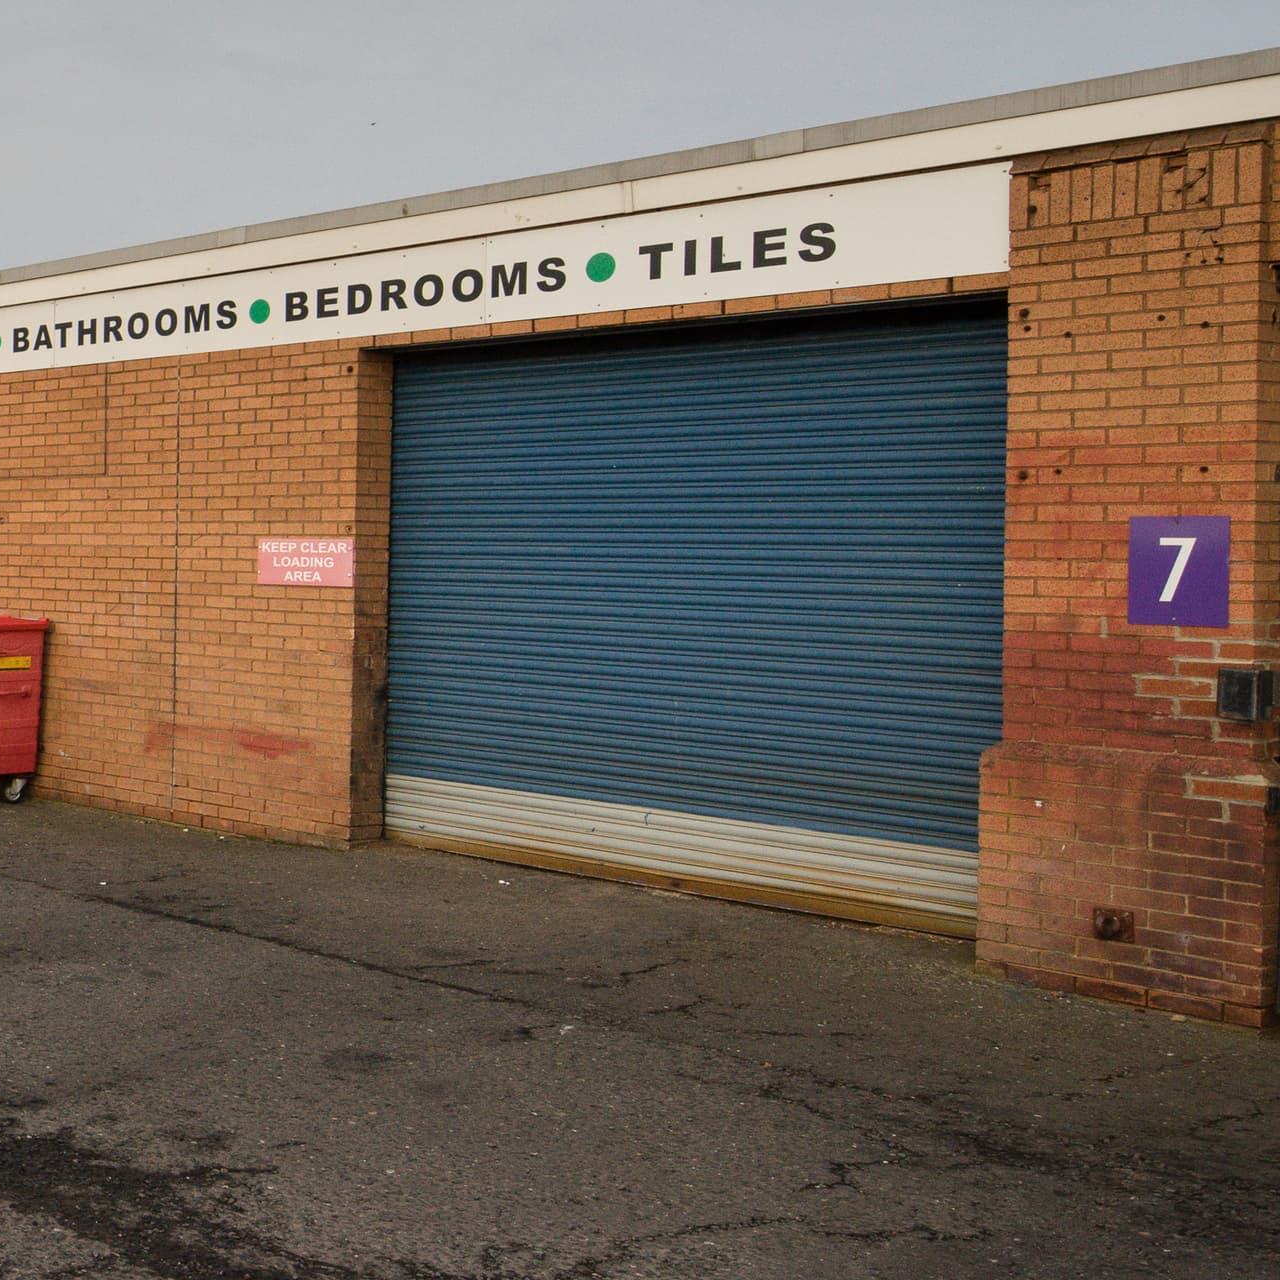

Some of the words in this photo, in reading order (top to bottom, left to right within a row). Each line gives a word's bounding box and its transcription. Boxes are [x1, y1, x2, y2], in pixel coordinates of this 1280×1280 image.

[12, 299, 239, 353] BATHROOMS
[284, 256, 567, 322] BEDROOMS
[639, 221, 838, 280] TILES
[261, 542, 297, 553] KEEP
[300, 542, 347, 553] CLEAR
[273, 556, 334, 568] LOADING
[1158, 537, 1197, 602] 7
[284, 571, 322, 582] AREA
